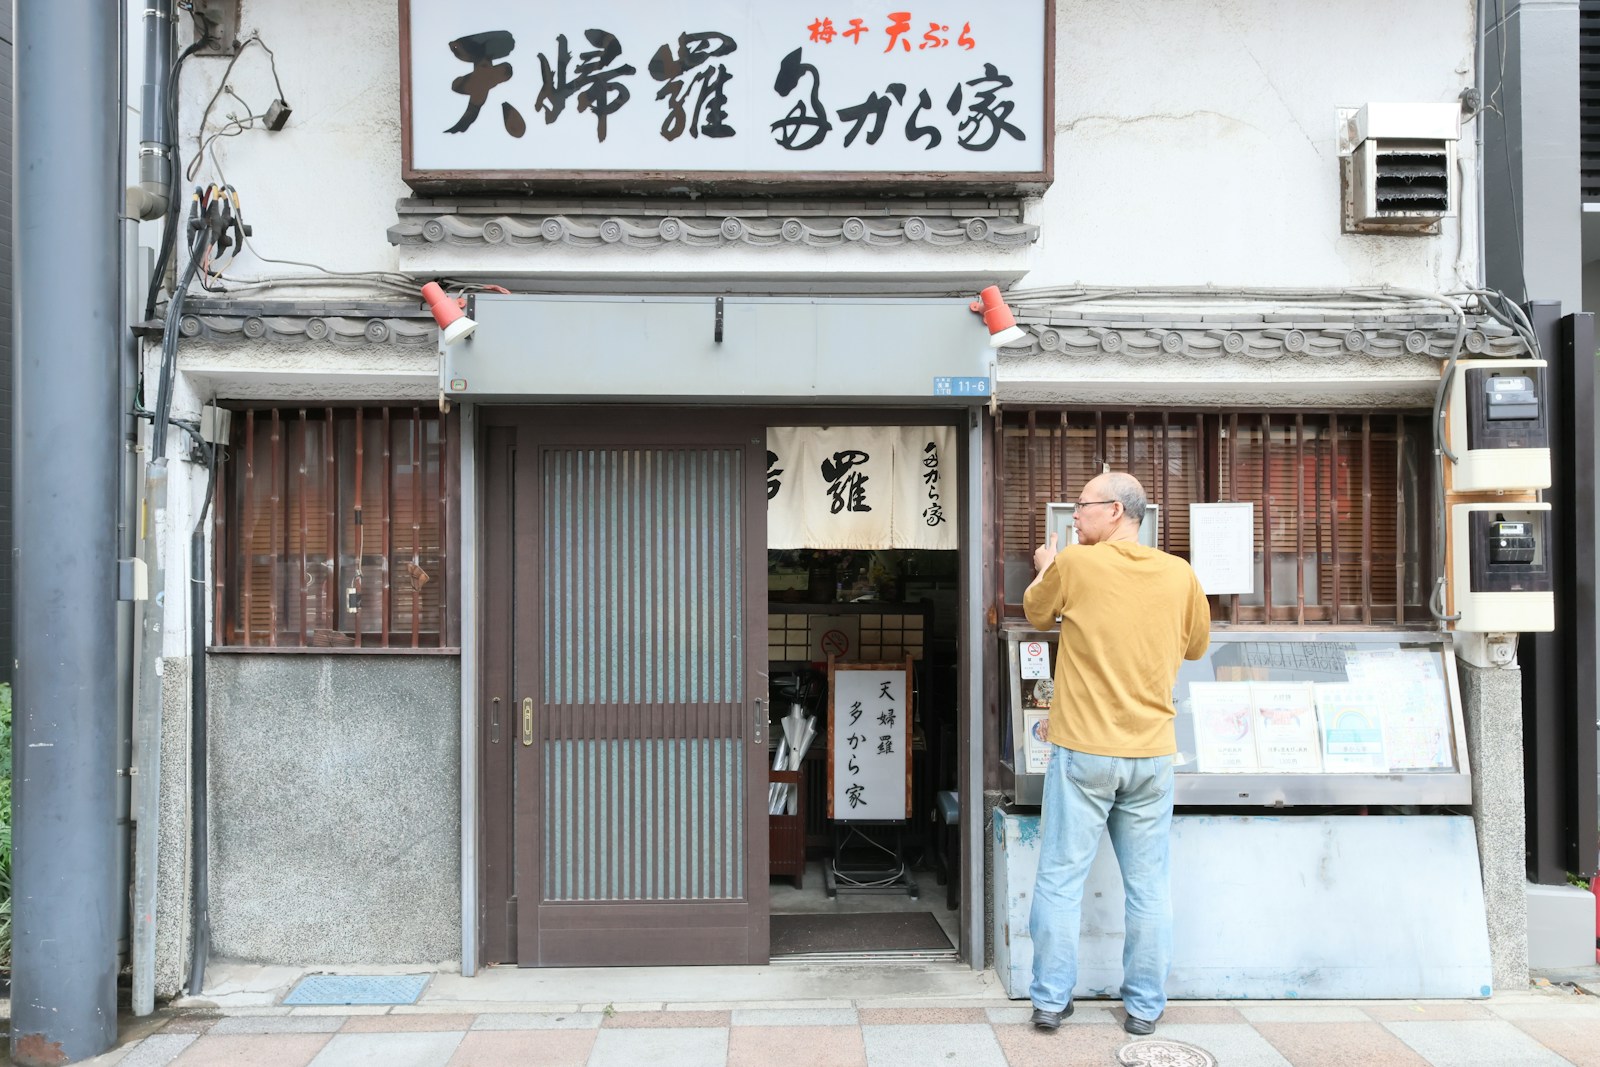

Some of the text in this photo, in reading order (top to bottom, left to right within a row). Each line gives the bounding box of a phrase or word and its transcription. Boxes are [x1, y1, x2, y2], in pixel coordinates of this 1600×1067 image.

[807, 12, 976, 53] 梅干 天ぷら
[443, 29, 738, 143] 天婦羅
[958, 381, 985, 392] 11-6
[845, 701, 868, 809] 多から家
[876, 681, 897, 755] 天婦羅
